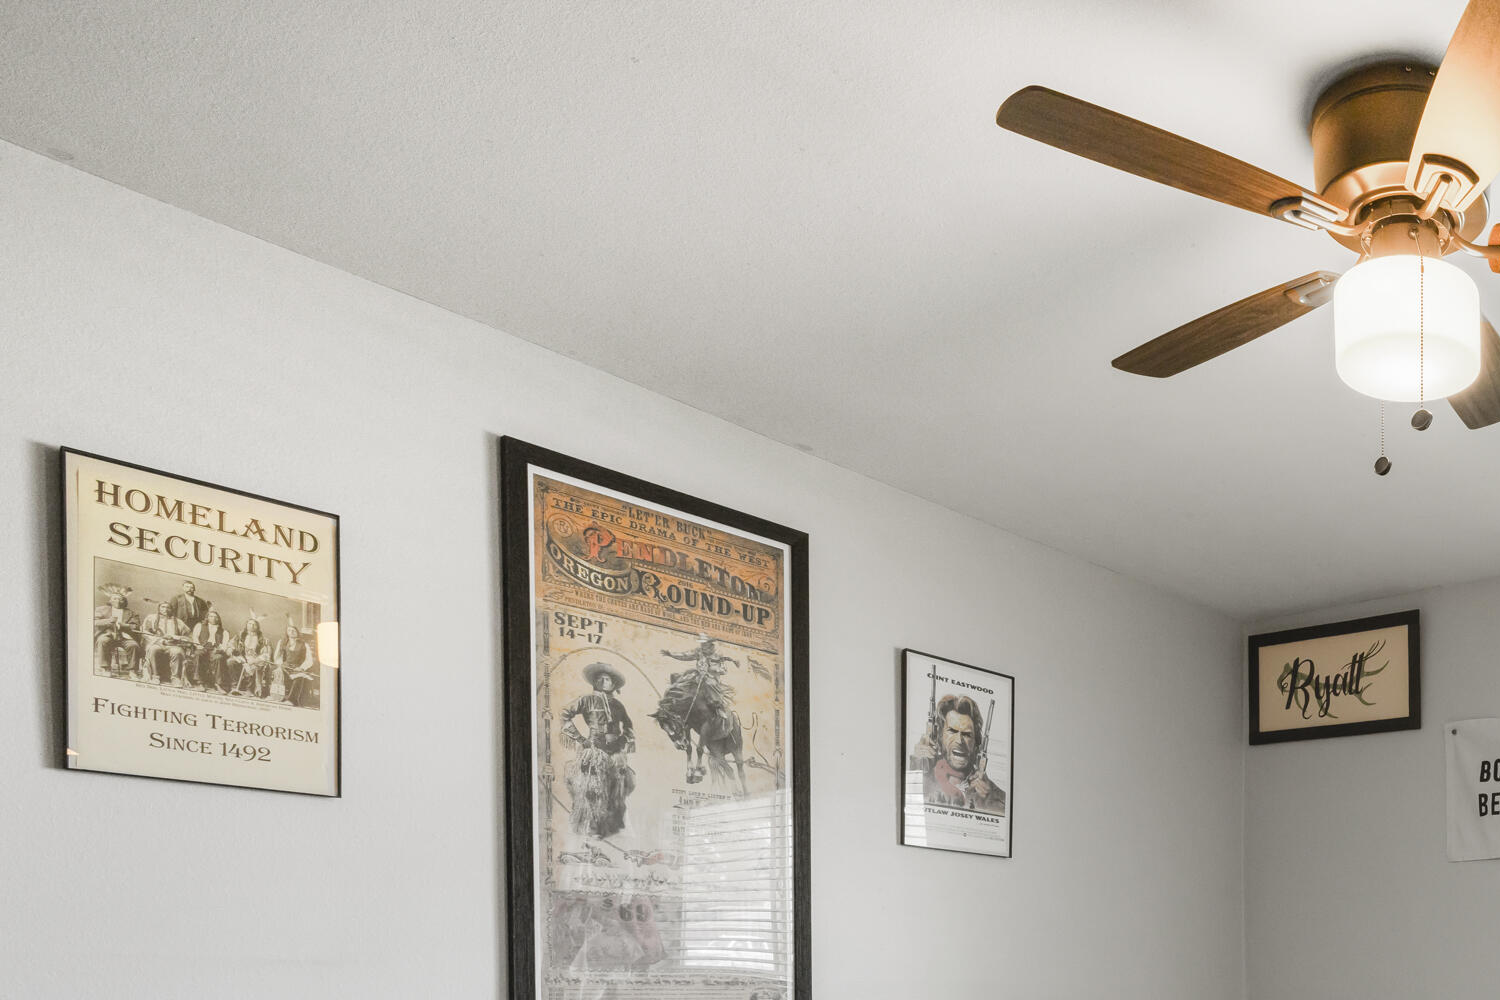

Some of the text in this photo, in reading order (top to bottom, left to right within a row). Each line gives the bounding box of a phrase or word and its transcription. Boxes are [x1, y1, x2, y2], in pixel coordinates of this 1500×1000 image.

[94, 479, 321, 553] HOMELAND
[552, 497, 583, 514] THE
[591, 509, 623, 525] EPIC
[630, 520, 676, 540] DRAMA
[683, 536, 699, 547] OF
[705, 543, 731, 557] THE
[738, 552, 770, 568] WEST
[107, 521, 312, 585] SECURITY
[550, 543, 630, 592] OREGON
[583, 521, 764, 602] PENDLETON
[634, 569, 770, 626] ROUND-UP
[554, 611, 607, 634] SEPT
[559, 627, 602, 644] 14-17
[951, 679, 994, 695] EASTWOOD
[92, 697, 198, 728] FIGHTING
[205, 713, 320, 744] TERRORISM
[149, 733, 272, 763] SINCE 1492
[924, 807, 1000, 824] TLAW JOSEY WALES
